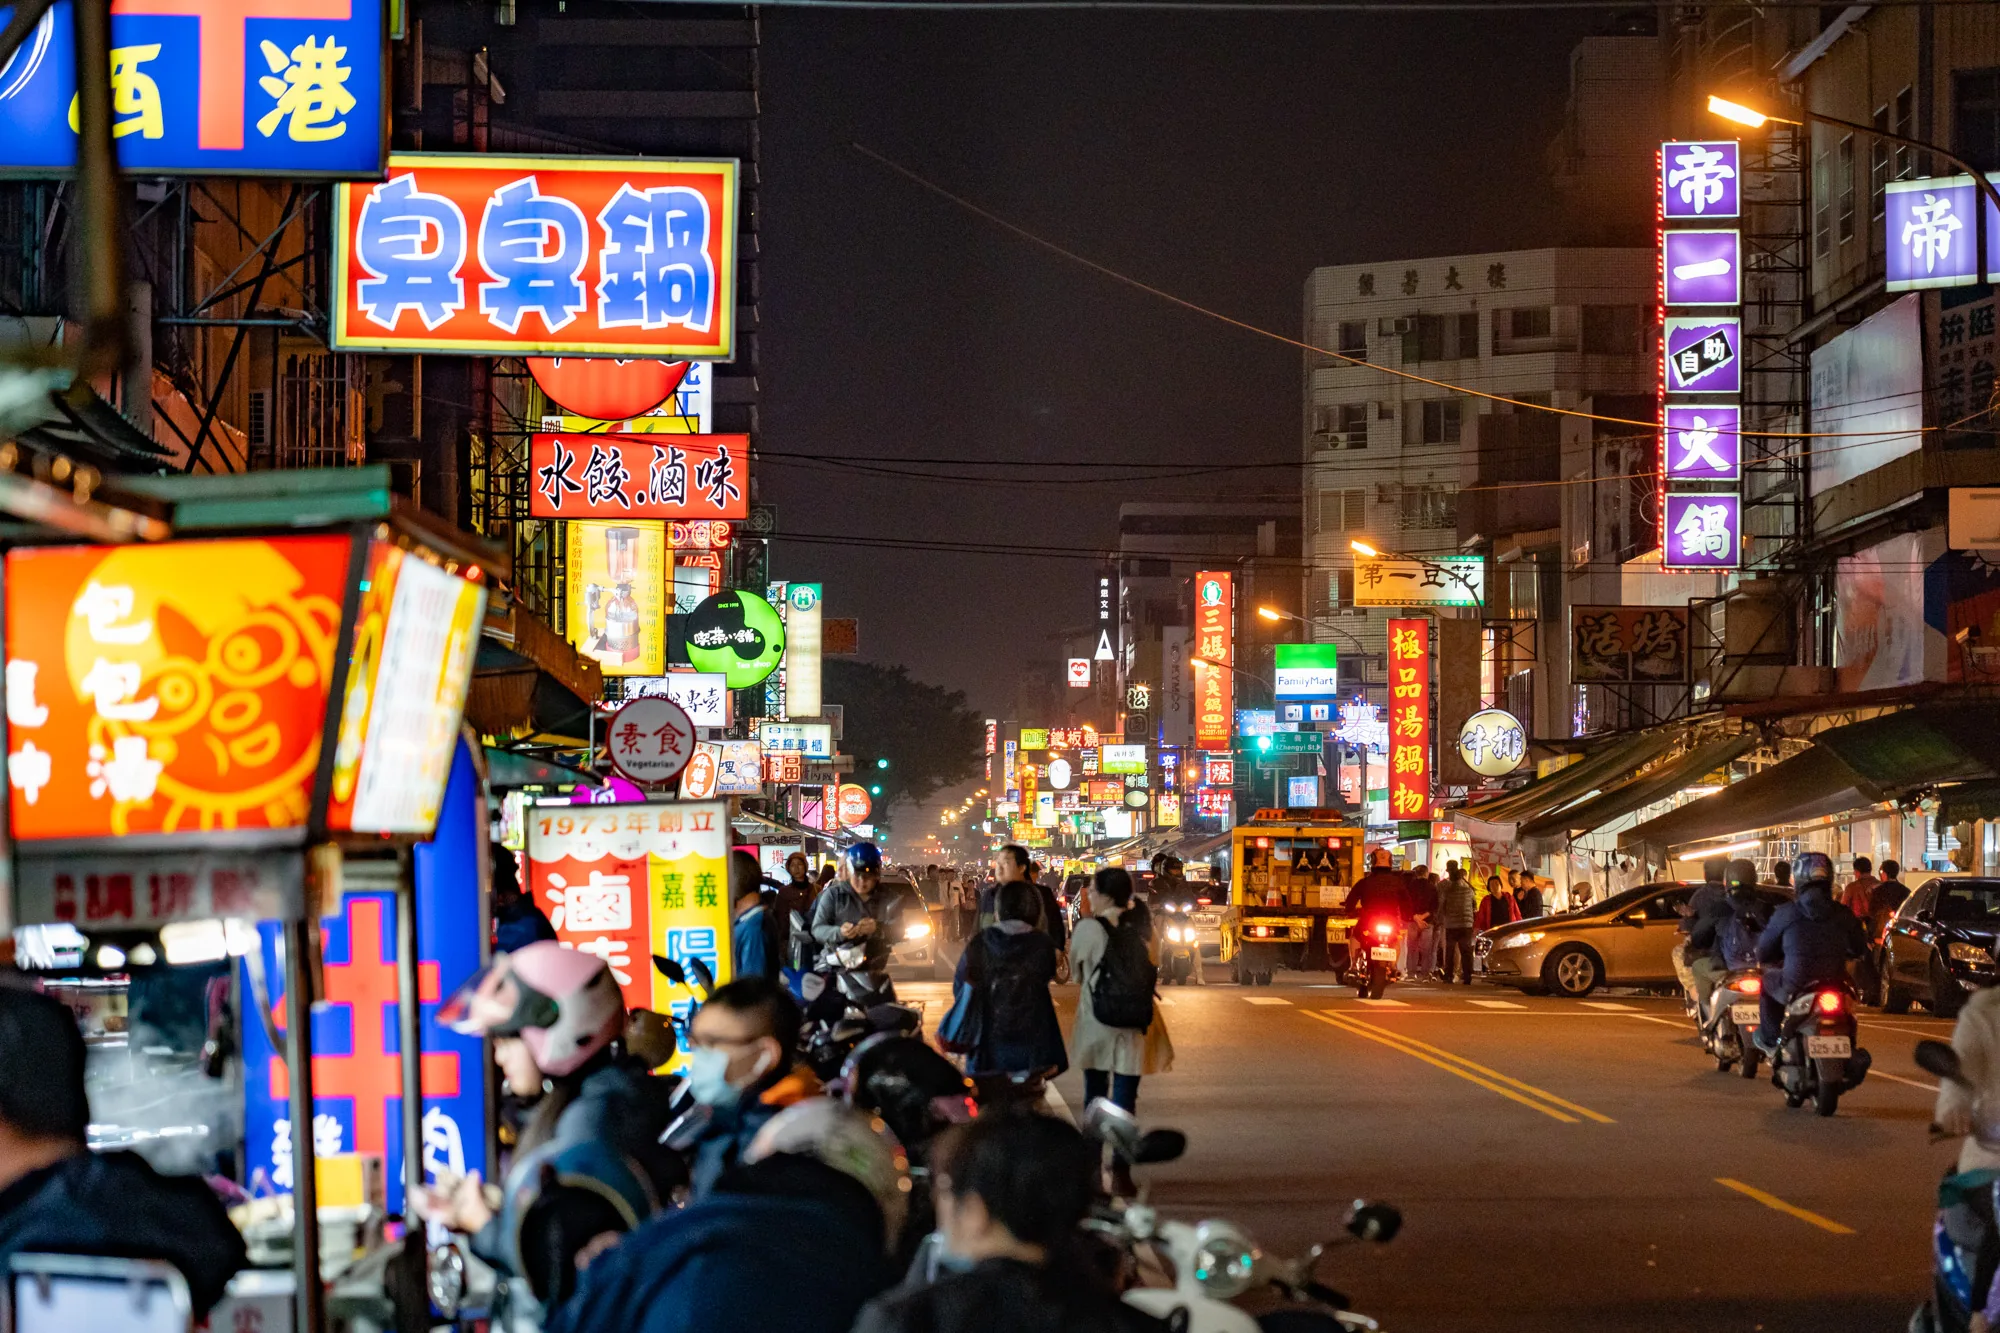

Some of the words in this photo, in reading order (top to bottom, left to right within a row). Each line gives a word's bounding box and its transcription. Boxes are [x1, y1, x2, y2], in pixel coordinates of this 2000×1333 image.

[1901, 193, 1963, 274] 帝
[1358, 563, 1480, 589] 第一豆花
[1200, 609, 1227, 712] 三媽臭臭鍋
[1277, 675, 1334, 688] FamilyMart
[1391, 627, 1425, 815] 極品湯鍋物
[615, 721, 686, 756] 素食
[1049, 730, 1100, 748] 鐵板燒
[1279, 744, 1306, 753] Zhengyi
[1461, 725, 1524, 766] 牛排
[626, 759, 675, 770] Vegetarian
[538, 810, 716, 837] 1973年創立
[661, 871, 718, 910] 嘉義
[1328, 929, 1345, 942] 767
